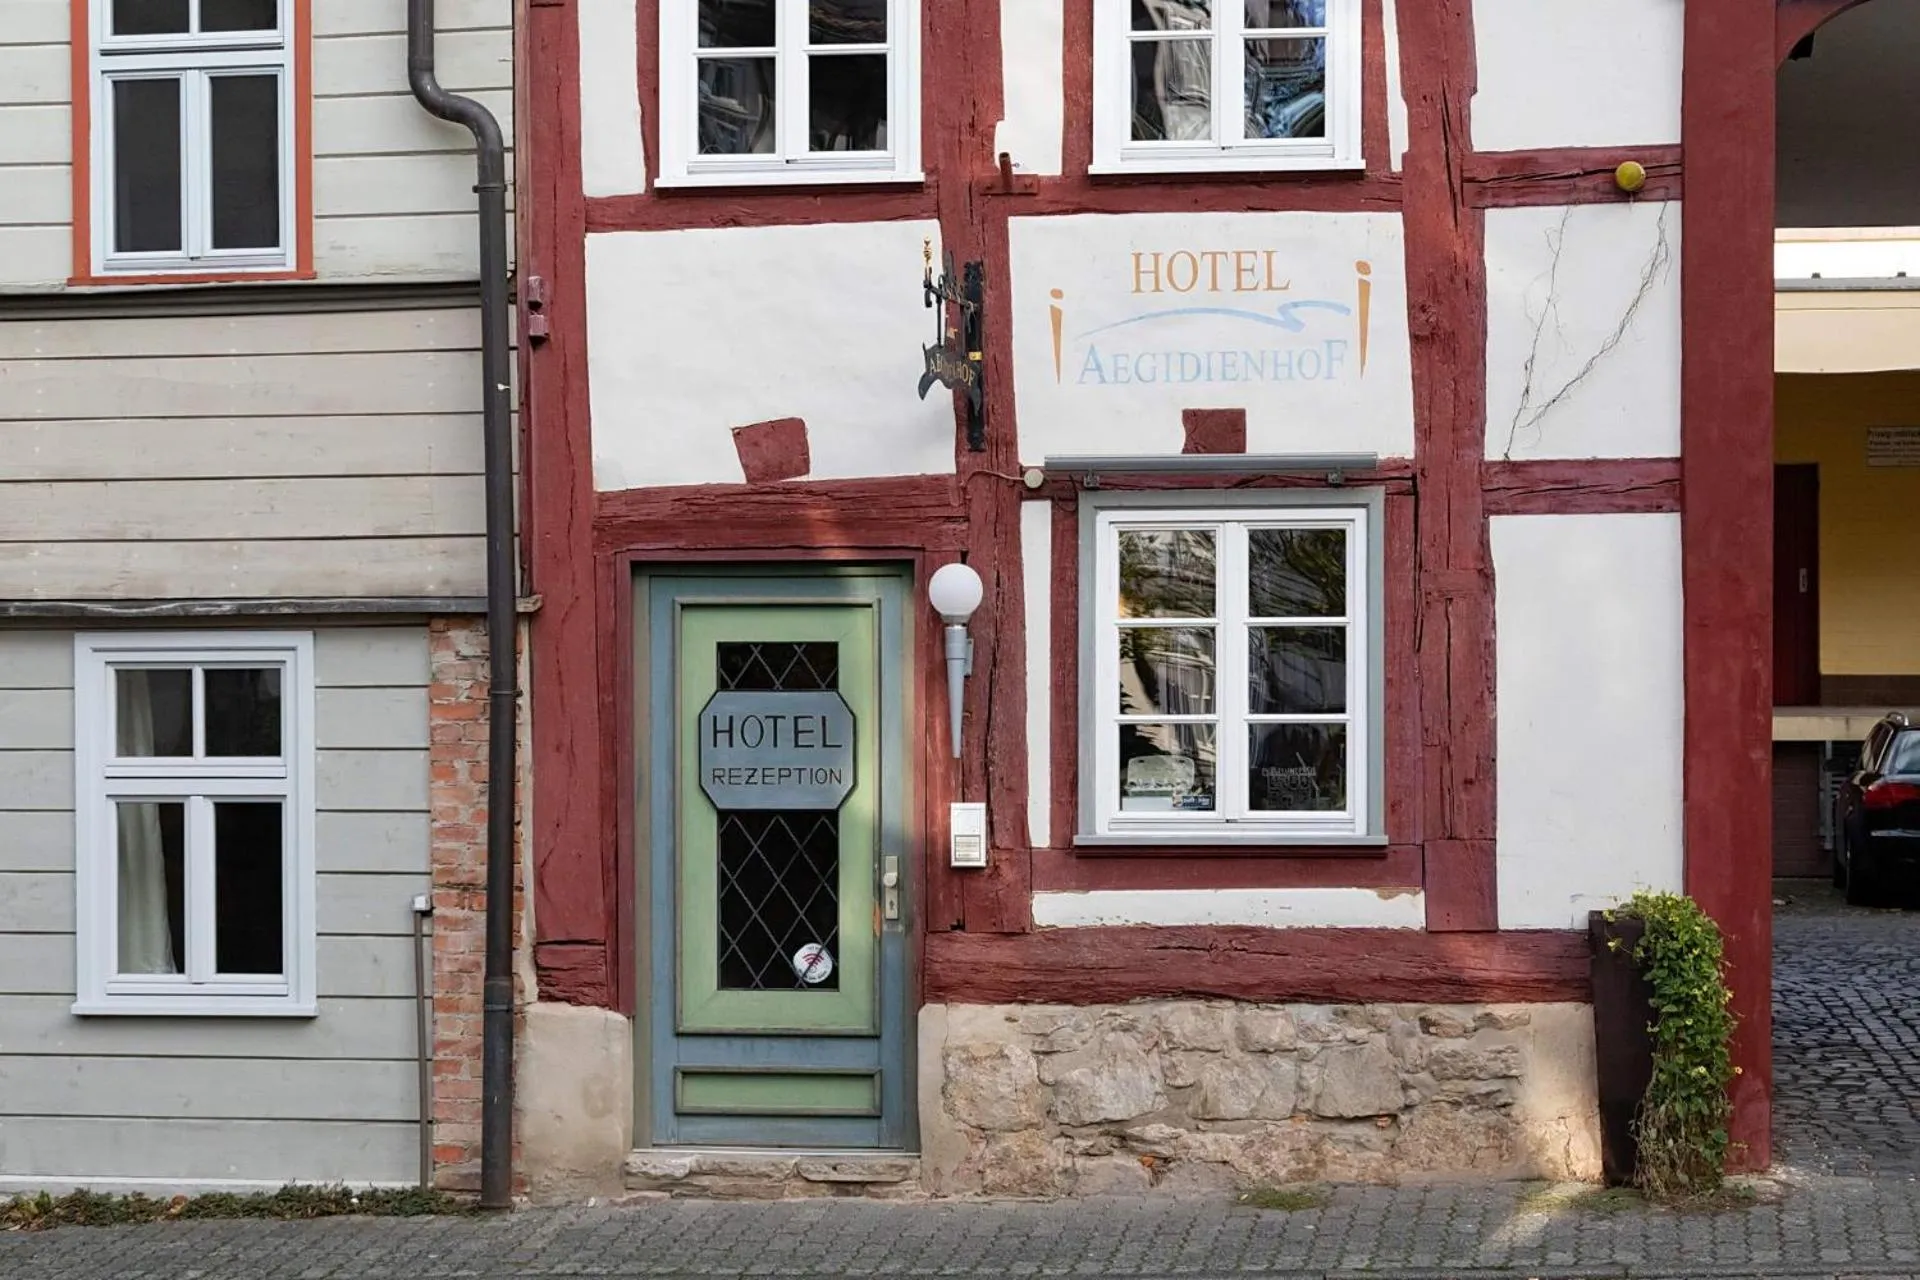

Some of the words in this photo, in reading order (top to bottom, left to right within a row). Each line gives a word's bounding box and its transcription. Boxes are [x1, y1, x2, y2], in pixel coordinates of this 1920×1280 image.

[1131, 250, 1290, 293] HOTEL
[1076, 339, 1348, 385] AEGIDIENHOF
[712, 714, 843, 748] HOTEL
[712, 767, 842, 785] REZEPTION
